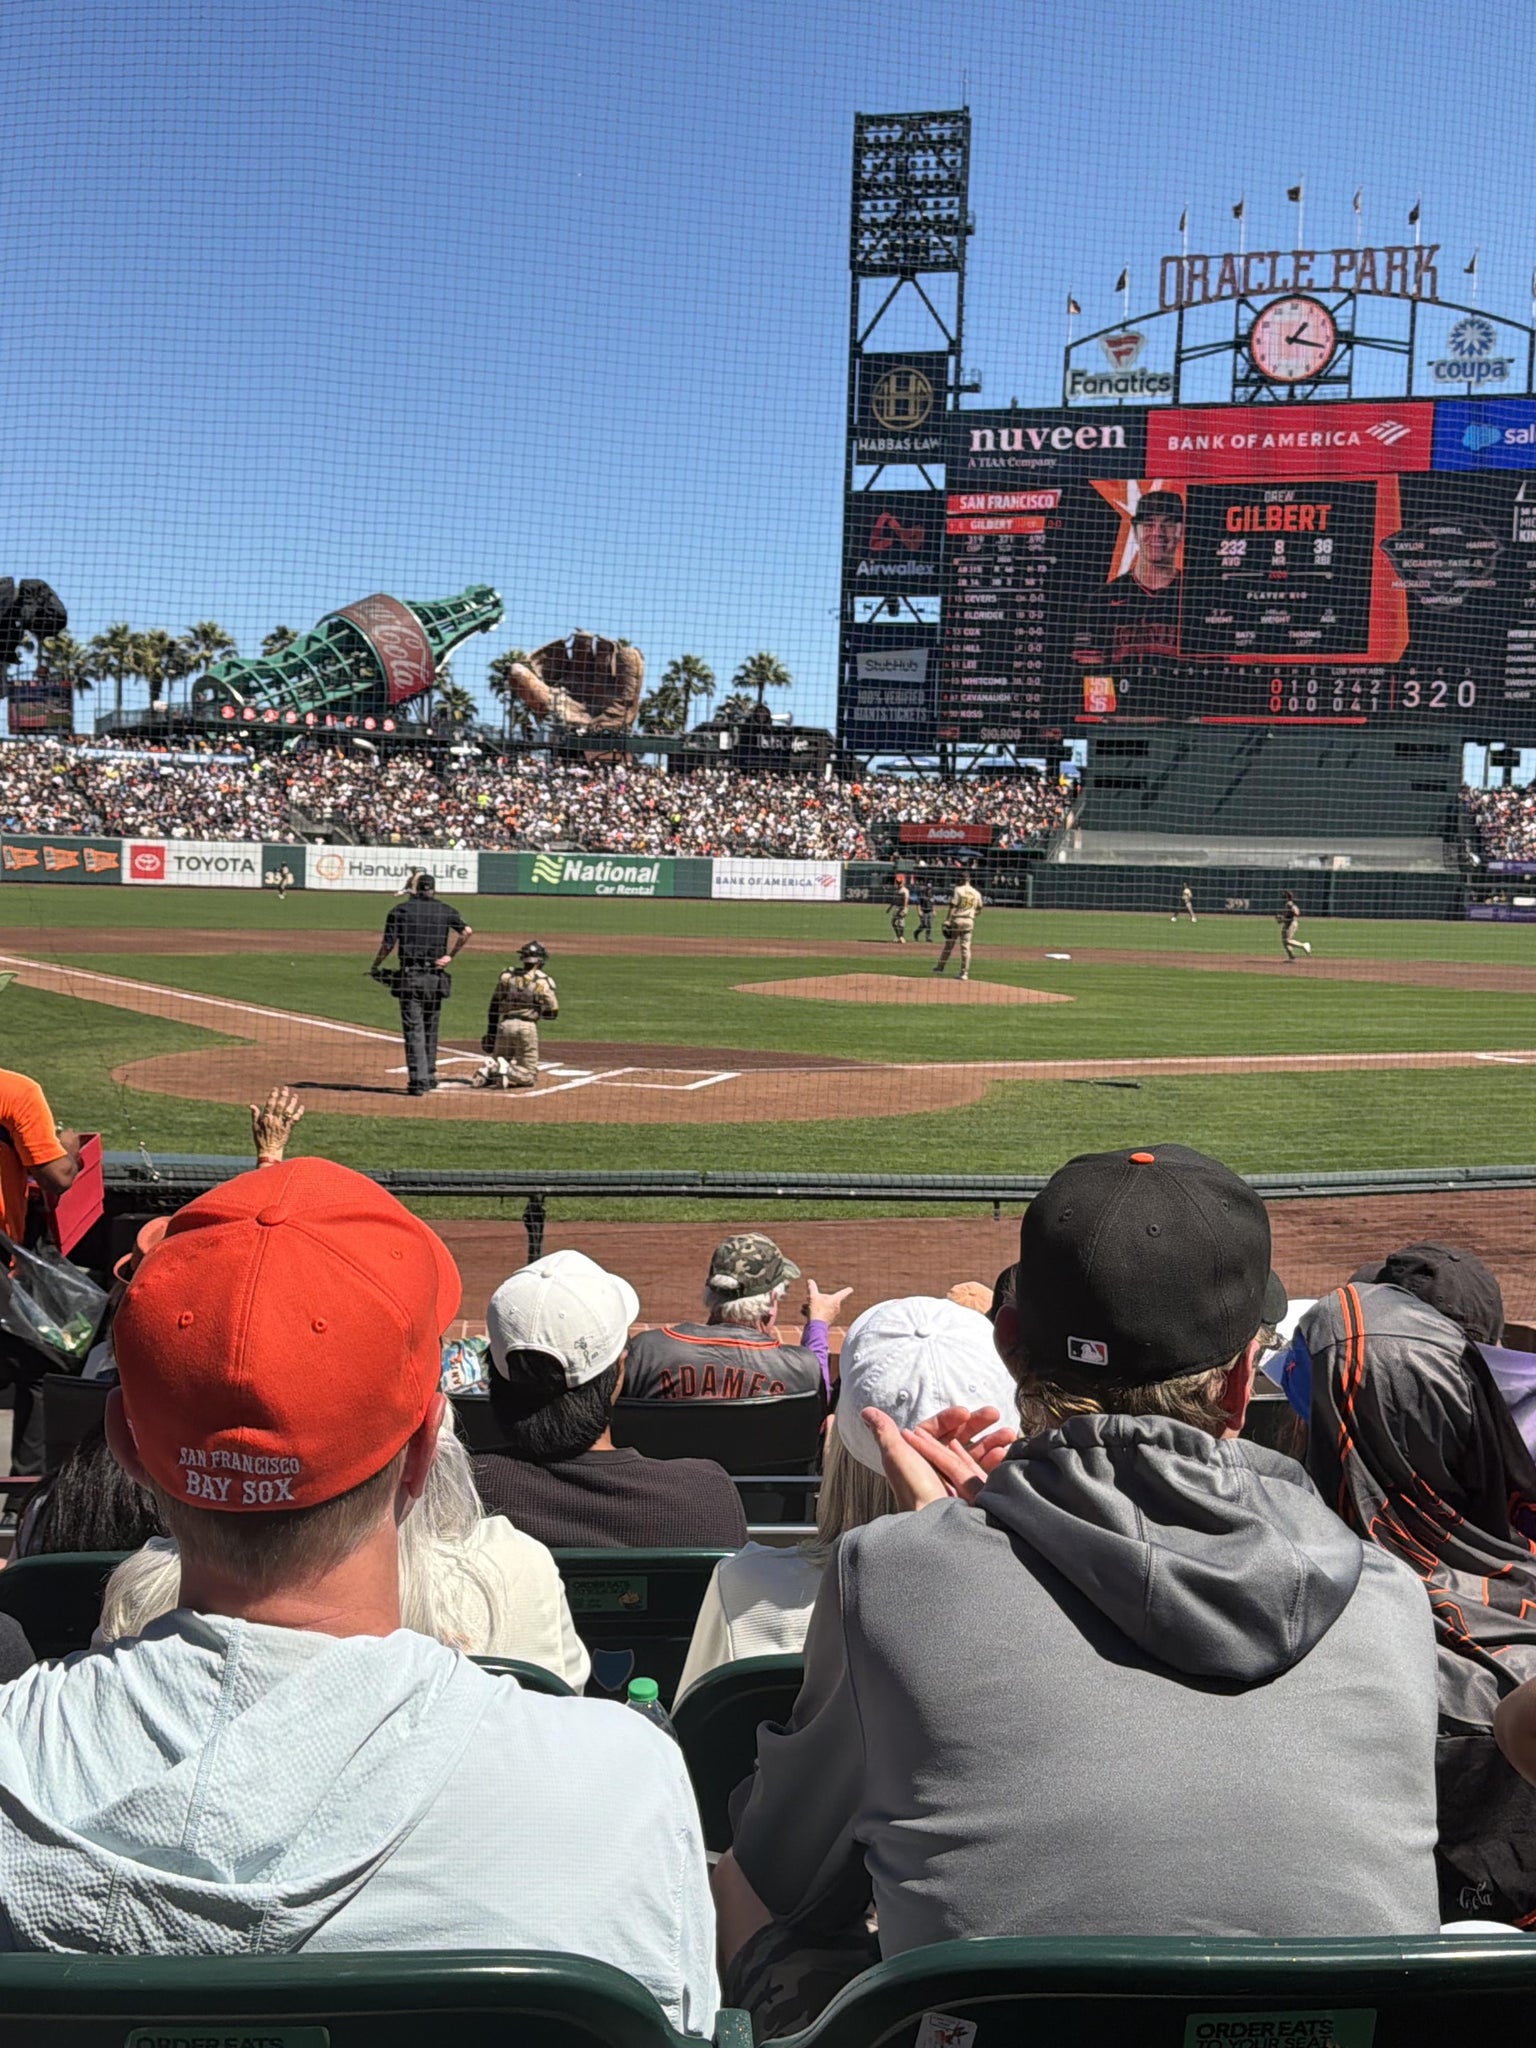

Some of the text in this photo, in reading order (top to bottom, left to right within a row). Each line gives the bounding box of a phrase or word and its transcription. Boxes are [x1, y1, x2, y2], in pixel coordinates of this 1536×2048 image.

[1159, 244, 1440, 312] ORACLE PARK
[1435, 361, 1505, 383] coupa
[1070, 369, 1171, 396] Fanatics
[859, 437, 940, 451] HABBAS LAW
[969, 425, 1127, 451] nuveen
[1168, 431, 1361, 450] BANK OF AMERICA
[1007, 457, 1057, 469] Company
[960, 494, 1054, 510] SAN FRANCISCO
[1264, 490, 1295, 503] DREW
[970, 519, 1013, 530] GILBERT
[1226, 504, 1332, 532] GILBERT
[1216, 540, 1247, 556] .232
[1274, 539, 1285, 555] 8
[856, 560, 934, 576] Airwallex
[1221, 555, 1331, 567] AVG HR RBI
[865, 660, 918, 672] StubHub
[1119, 679, 1129, 693] 0
[1270, 679, 1282, 694] 0
[1291, 680, 1298, 694] 1
[1307, 680, 1318, 694] 0
[1334, 680, 1344, 694] 2
[1351, 680, 1362, 694] 4
[1370, 680, 1380, 694] 2
[1403, 680, 1476, 708] 3 2 0
[1269, 695, 1281, 712] 0
[1288, 697, 1299, 712] 0
[1306, 697, 1317, 712] 0
[1333, 697, 1343, 712] 0
[1351, 697, 1361, 711] 4
[1371, 697, 1378, 711] 1
[927, 828, 966, 840] Adobe
[174, 855, 255, 873] TOYOTA
[433, 864, 469, 879] Life
[563, 859, 659, 884] National
[596, 884, 654, 896] Car Rental
[716, 876, 813, 888] BANK OF AMERICA
[179, 1447, 300, 1475] SAN FRANCISCO
[186, 1469, 295, 1504] BAY SOX
[1196, 2019, 1334, 2039] ORDER EATS
[1229, 2037, 1279, 2048] YOUR
